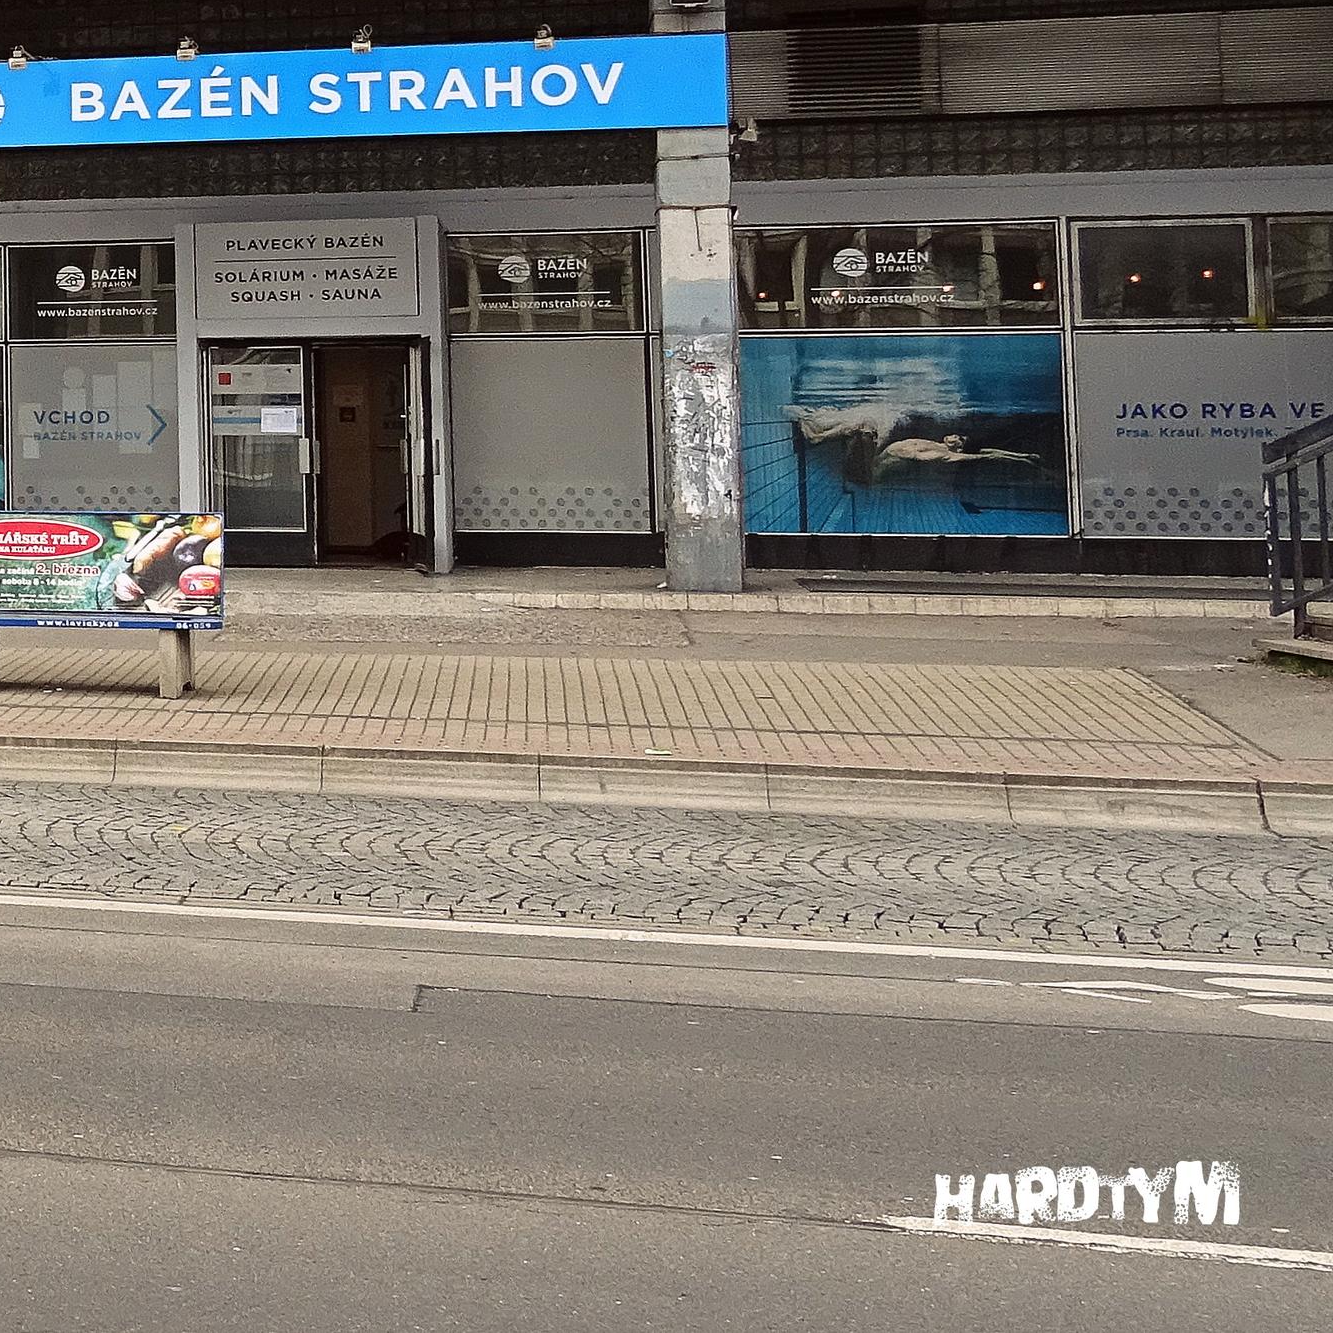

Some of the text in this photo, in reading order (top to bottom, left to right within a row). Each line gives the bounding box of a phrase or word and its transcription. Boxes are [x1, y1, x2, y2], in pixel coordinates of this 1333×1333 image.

[70, 61, 624, 123] BAZÉN STRAHOV
[225, 233, 385, 252] PLAVECKÝ BAZÉN
[214, 263, 399, 283] SOLÁRIUM MASÁŽE
[537, 271, 583, 279] STRAHOV
[91, 280, 133, 289] STRAHOV
[230, 288, 382, 303] SQUASH SAUNA
[811, 293, 955, 305] www.bazenstrahov.cz
[478, 297, 612, 310] www.bazenstrahov.cz
[37, 305, 159, 318] www.bazenstrahov.cz
[33, 410, 110, 424] VCHOD
[1115, 402, 1326, 420] JAKO RYBA VE
[33, 429, 142, 441] BAZÉN STRAHOV
[1116, 426, 1153, 438] Prsa.
[50, 530, 90, 546] TRHY
[35, 563, 51, 575] 2.
[52, 562, 101, 576] března
[36, 619, 120, 629] www.lavicky.cz
